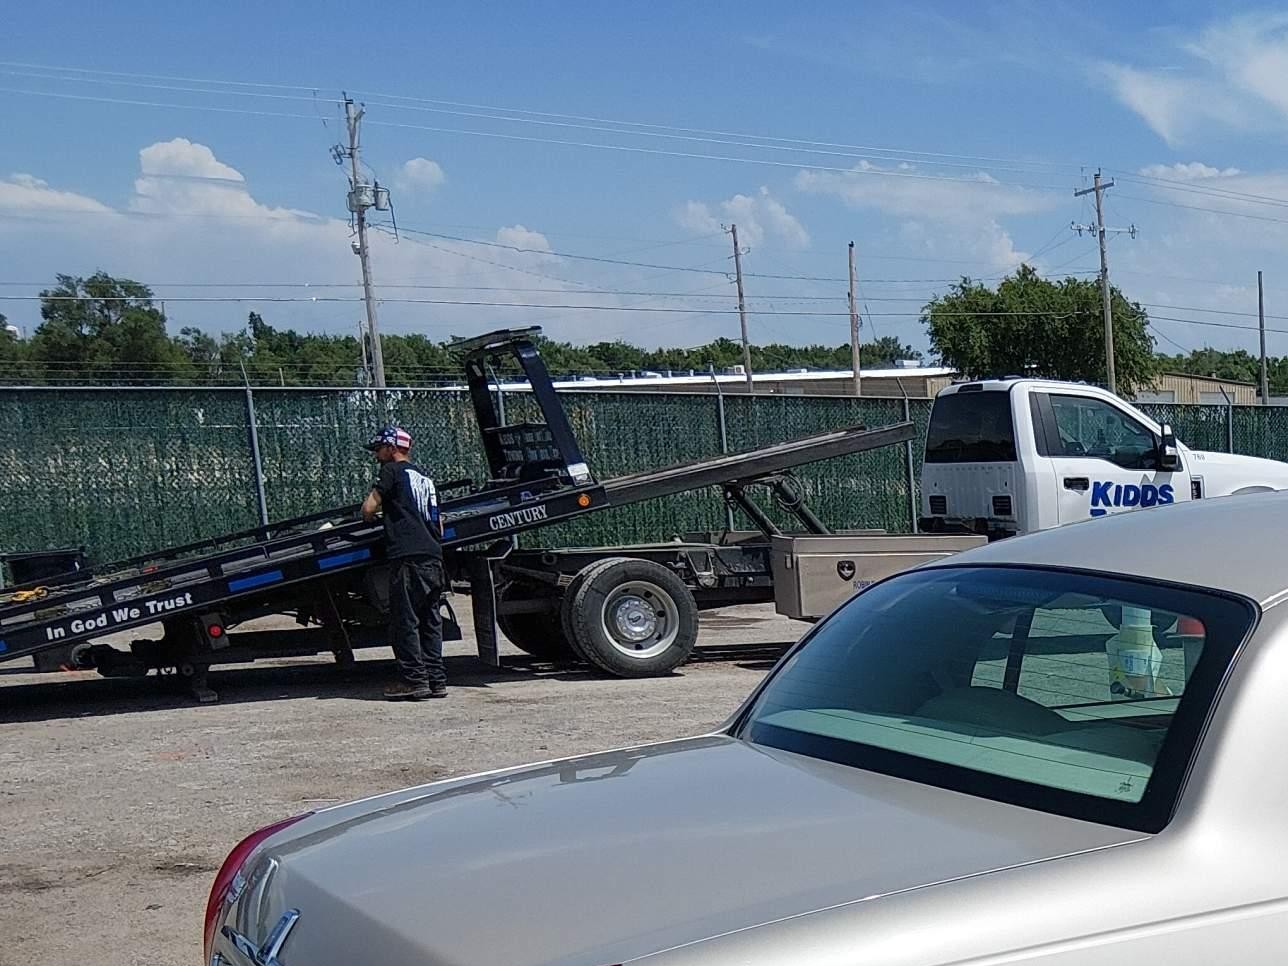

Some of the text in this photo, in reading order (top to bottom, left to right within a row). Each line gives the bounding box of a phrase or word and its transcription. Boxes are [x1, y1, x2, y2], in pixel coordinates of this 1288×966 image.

[1090, 481, 1175, 508] KIDDS
[489, 504, 549, 531] CENTURY
[46, 592, 194, 640] In God We Trust
